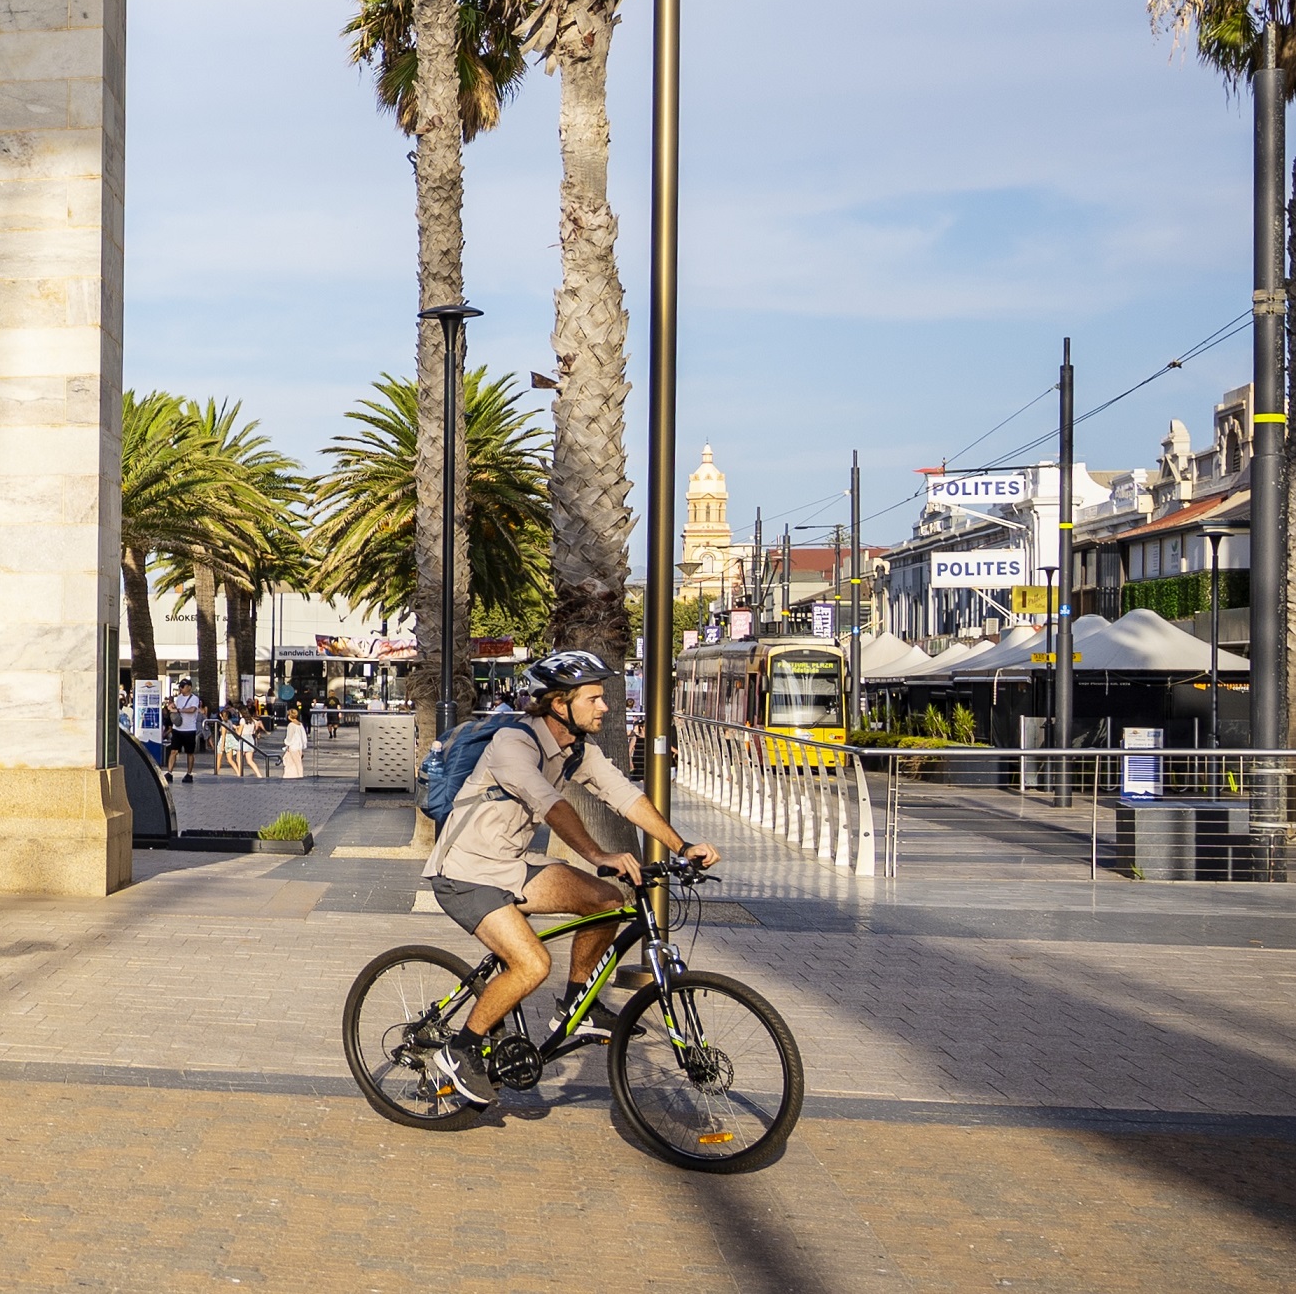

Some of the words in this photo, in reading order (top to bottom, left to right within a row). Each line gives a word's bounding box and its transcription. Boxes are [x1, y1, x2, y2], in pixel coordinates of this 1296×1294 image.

[933, 481, 1020, 496] POLITES
[937, 561, 1021, 577] POLITES
[165, 614, 220, 622] SMOKET
[278, 649, 315, 657] sandwich
[568, 944, 615, 1017] FLUID
